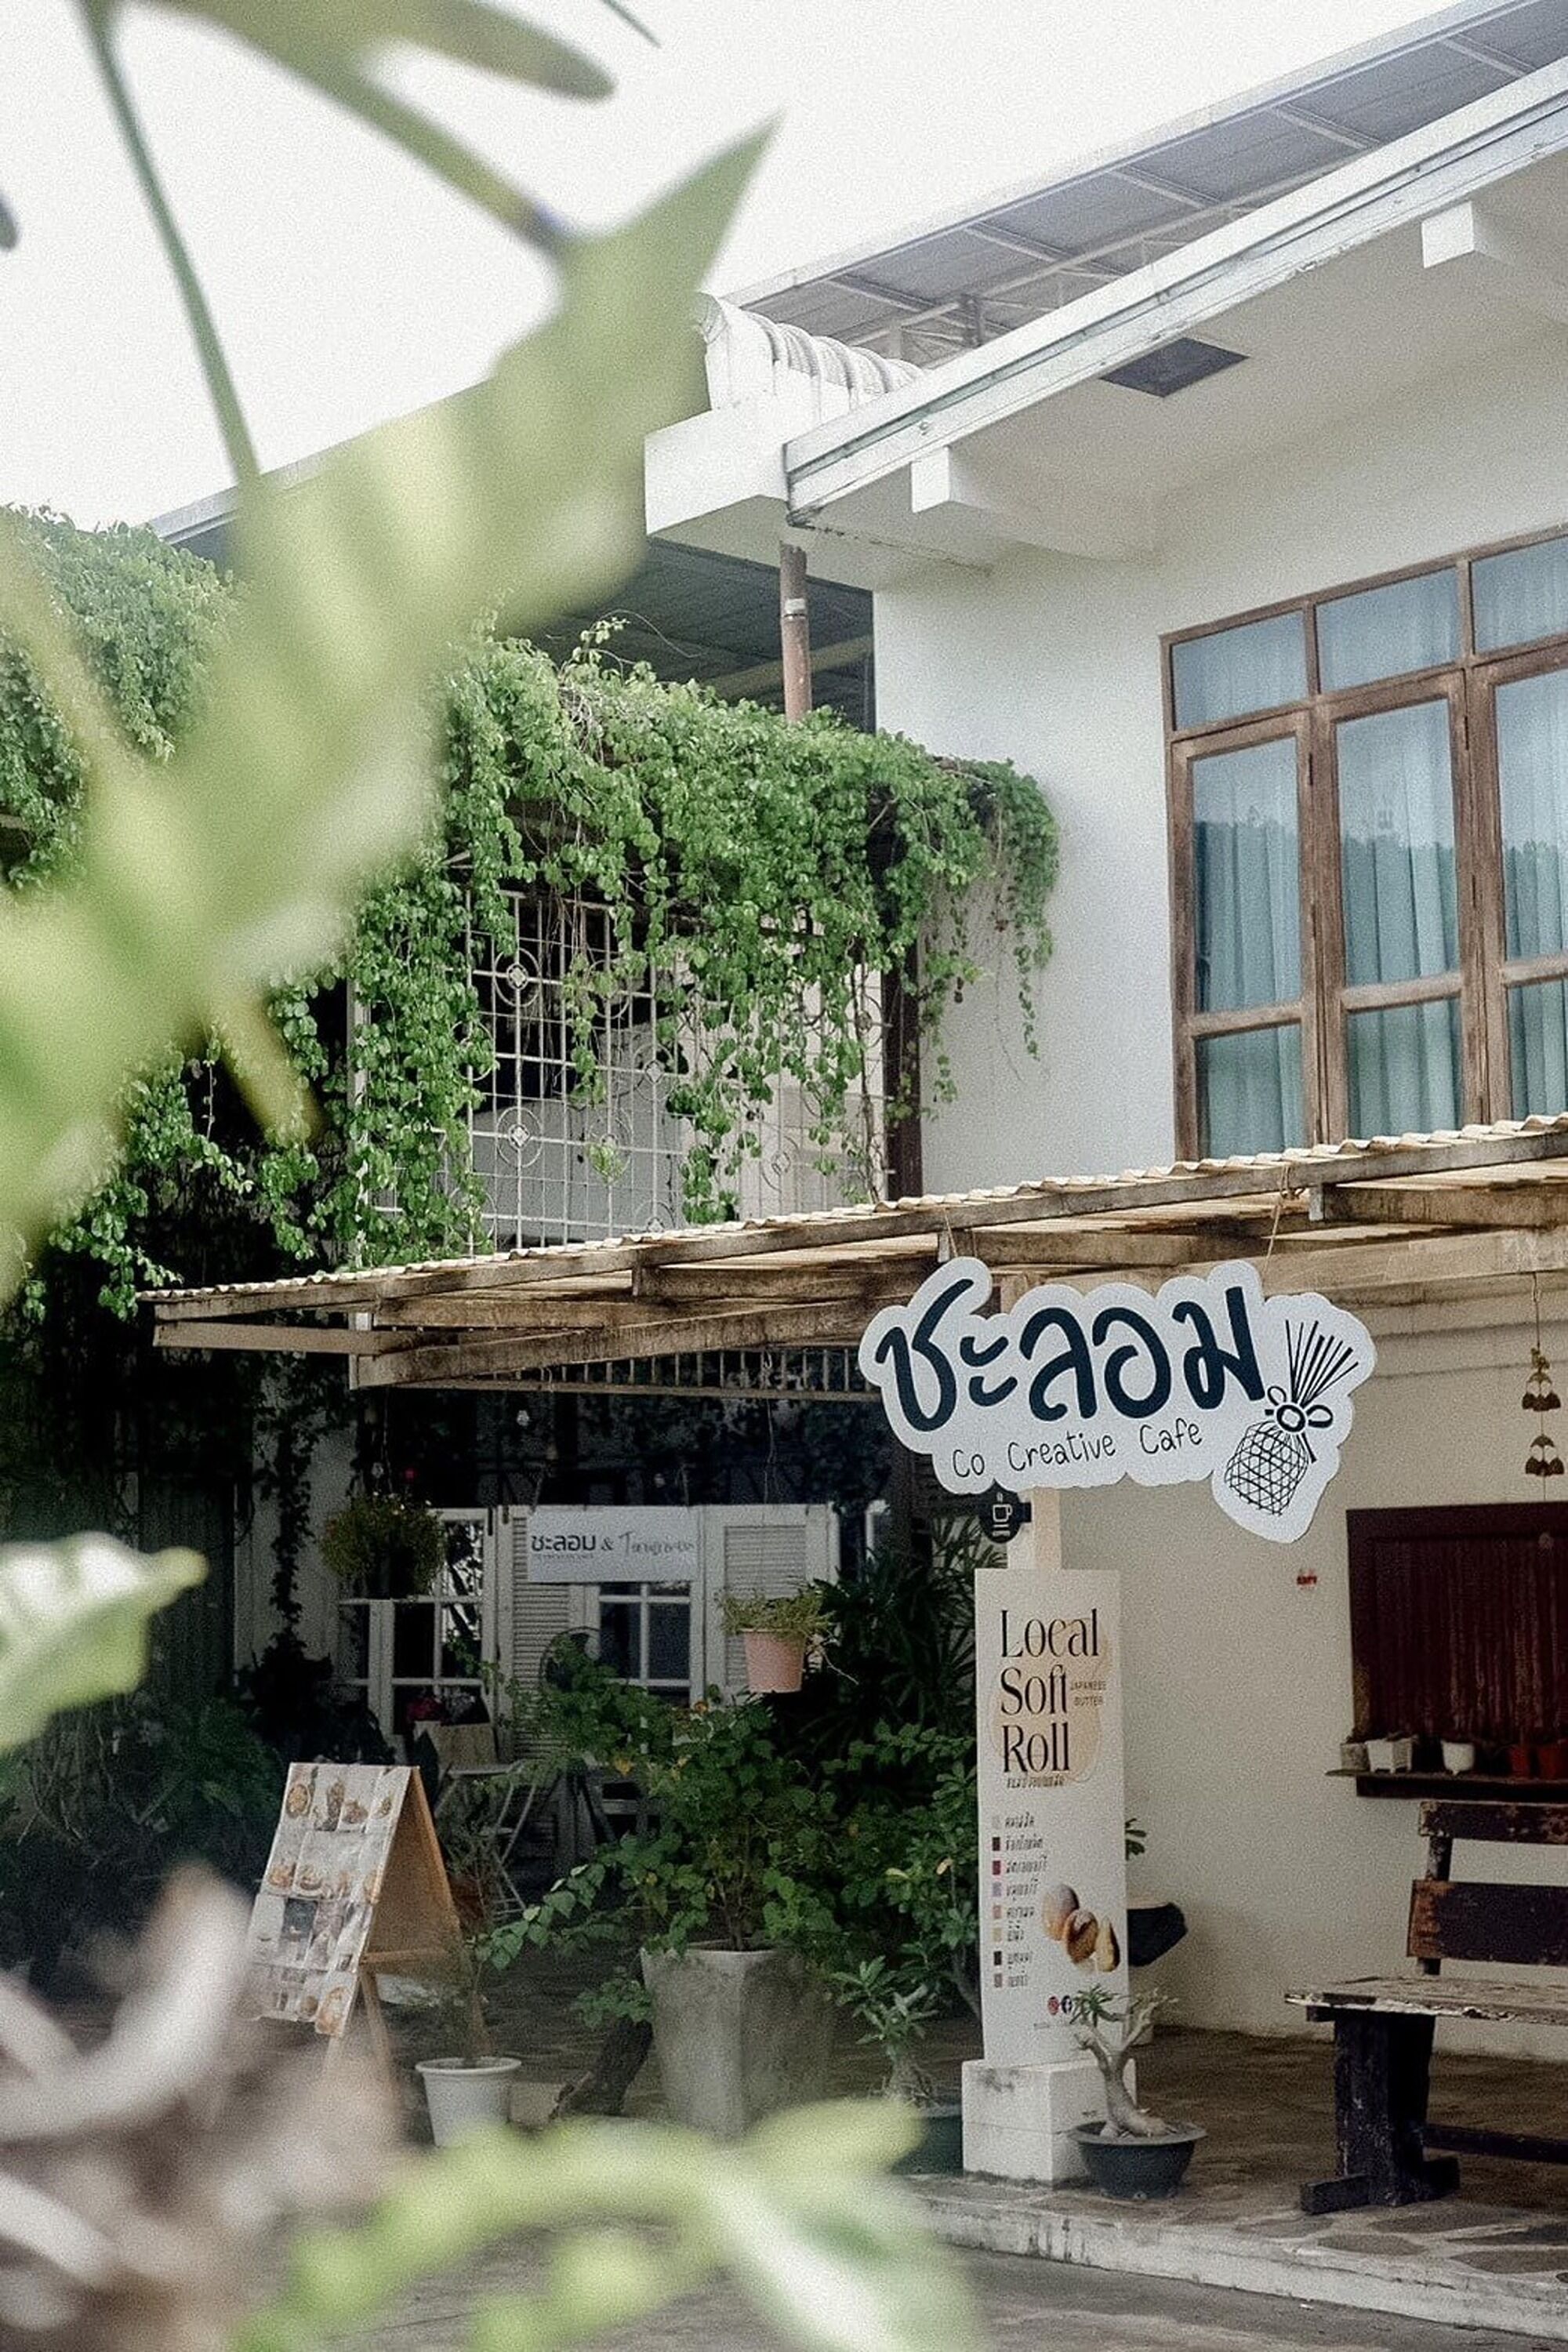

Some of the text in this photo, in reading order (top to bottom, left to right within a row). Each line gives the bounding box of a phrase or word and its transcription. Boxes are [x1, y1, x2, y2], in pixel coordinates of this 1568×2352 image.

[874, 1277, 1265, 1432] ชะลอม
[952, 1417, 1203, 1479] Co Creative Cafe
[601, 1537, 615, 1552] &
[1000, 1607, 1099, 1658] Local
[1000, 1664, 1068, 1715] Soft
[1002, 1722, 1070, 1773] Roll
